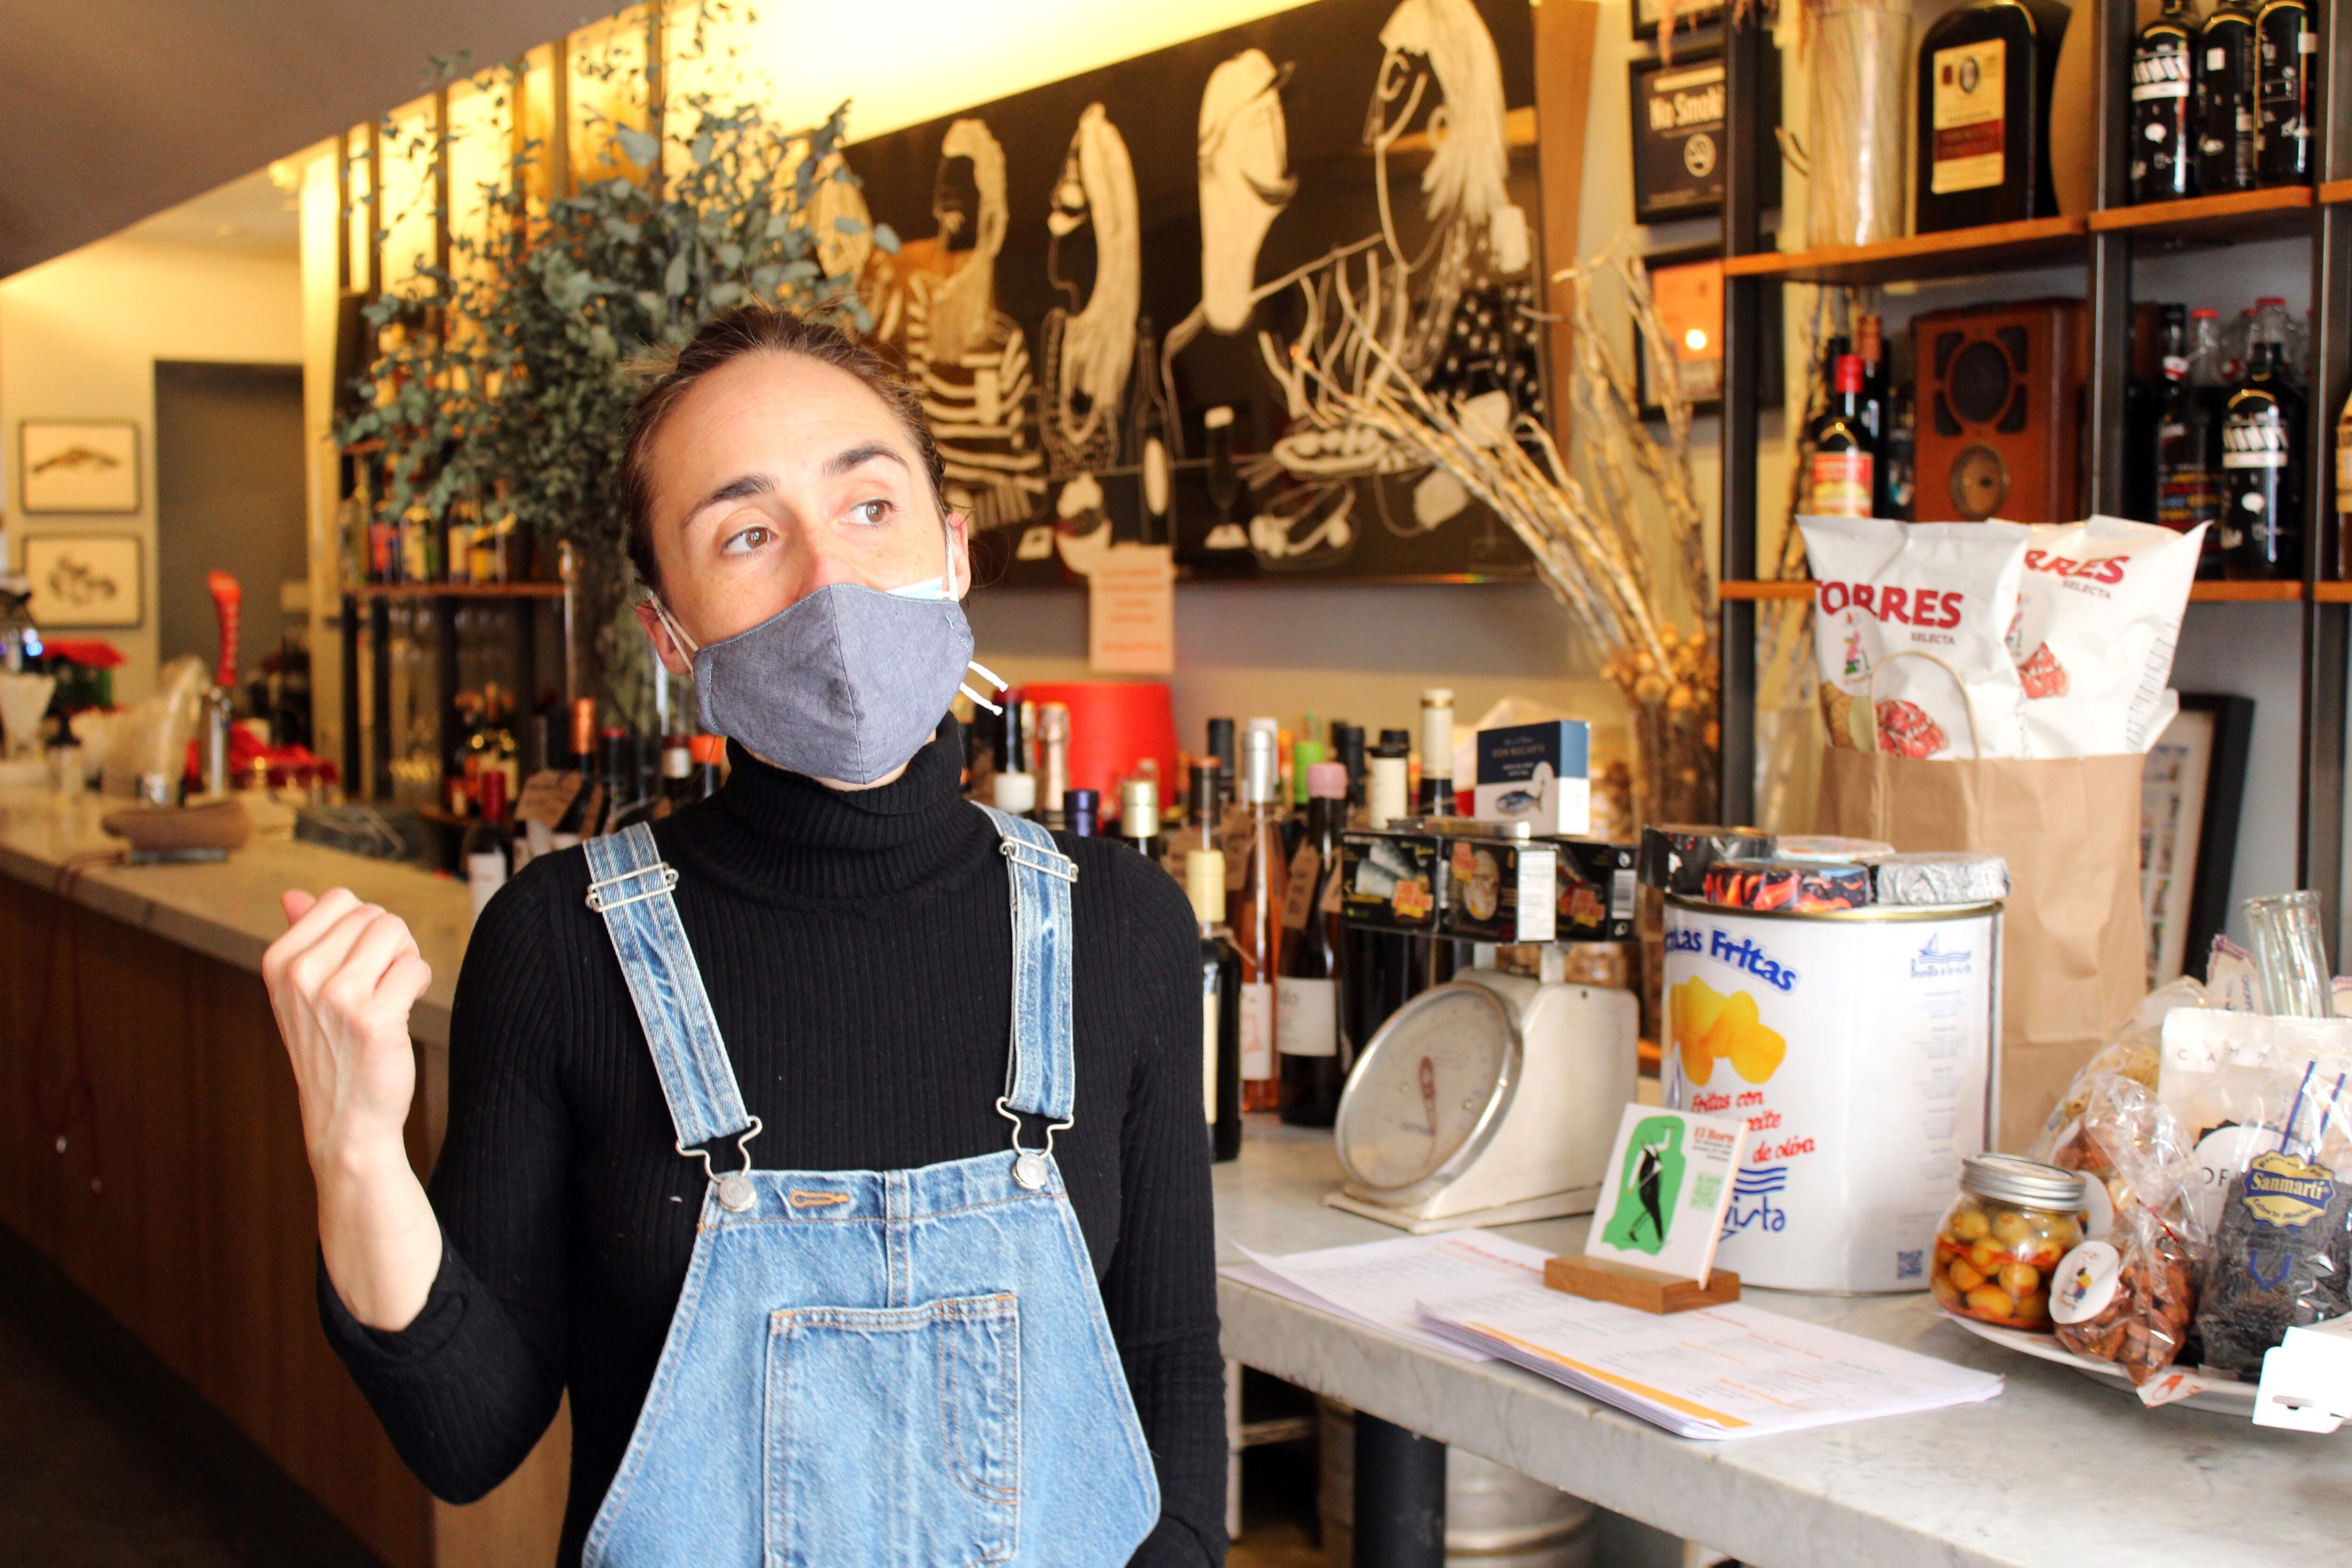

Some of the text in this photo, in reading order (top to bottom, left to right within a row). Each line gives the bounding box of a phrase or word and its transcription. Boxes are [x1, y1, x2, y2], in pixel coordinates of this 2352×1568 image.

[2025, 550, 2130, 584] RRES
[1816, 580, 1963, 629] ORRES
[1711, 930, 1796, 991] Fritas
[1752, 1140, 1772, 1163] de
